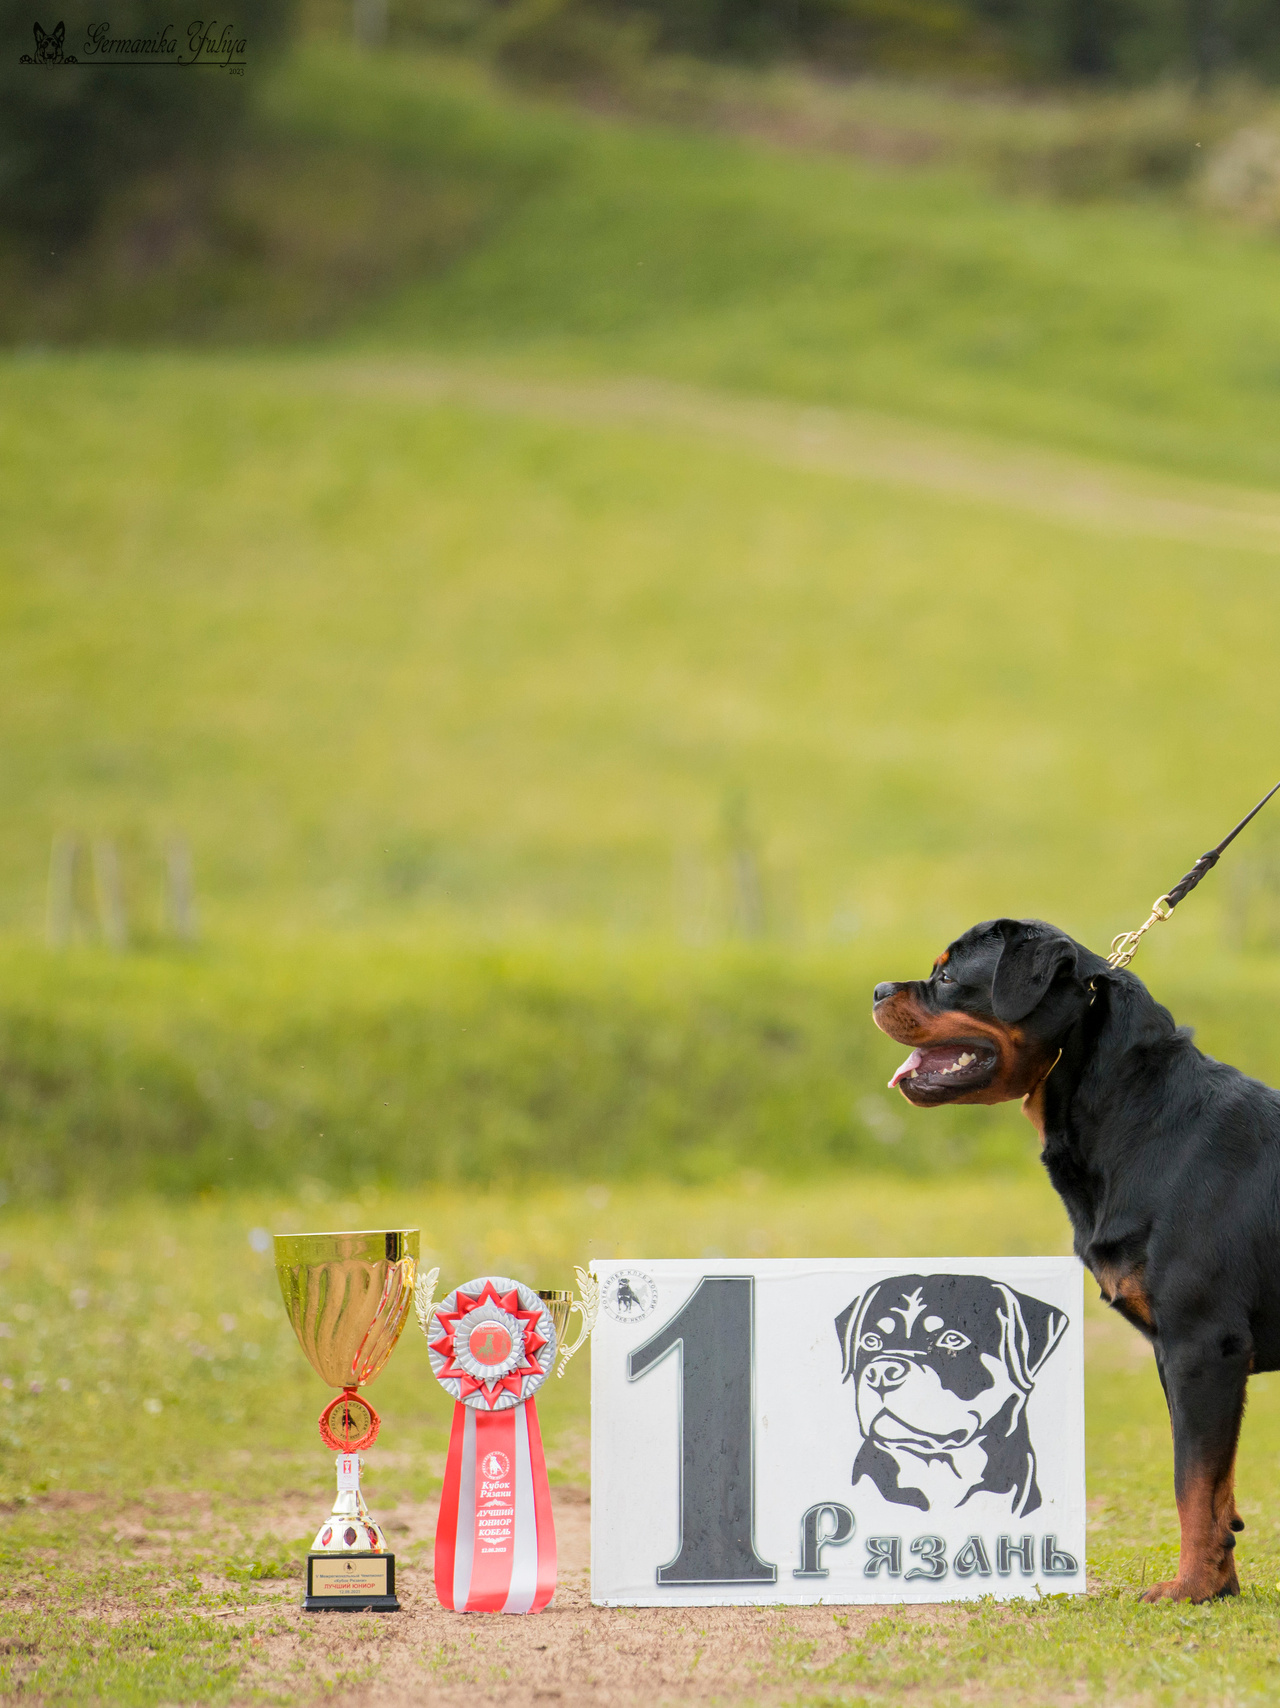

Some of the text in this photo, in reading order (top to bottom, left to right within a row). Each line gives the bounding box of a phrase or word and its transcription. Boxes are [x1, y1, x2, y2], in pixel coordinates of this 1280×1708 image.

[626, 1275, 778, 1585] 1
[481, 1481, 510, 1491] Кубок
[480, 1490, 511, 1498] Рязани
[476, 1507, 514, 1517] ЛУЧШИЙ
[478, 1519, 512, 1527] ЮНИОР
[478, 1528, 511, 1536] КОБЕЛЬ
